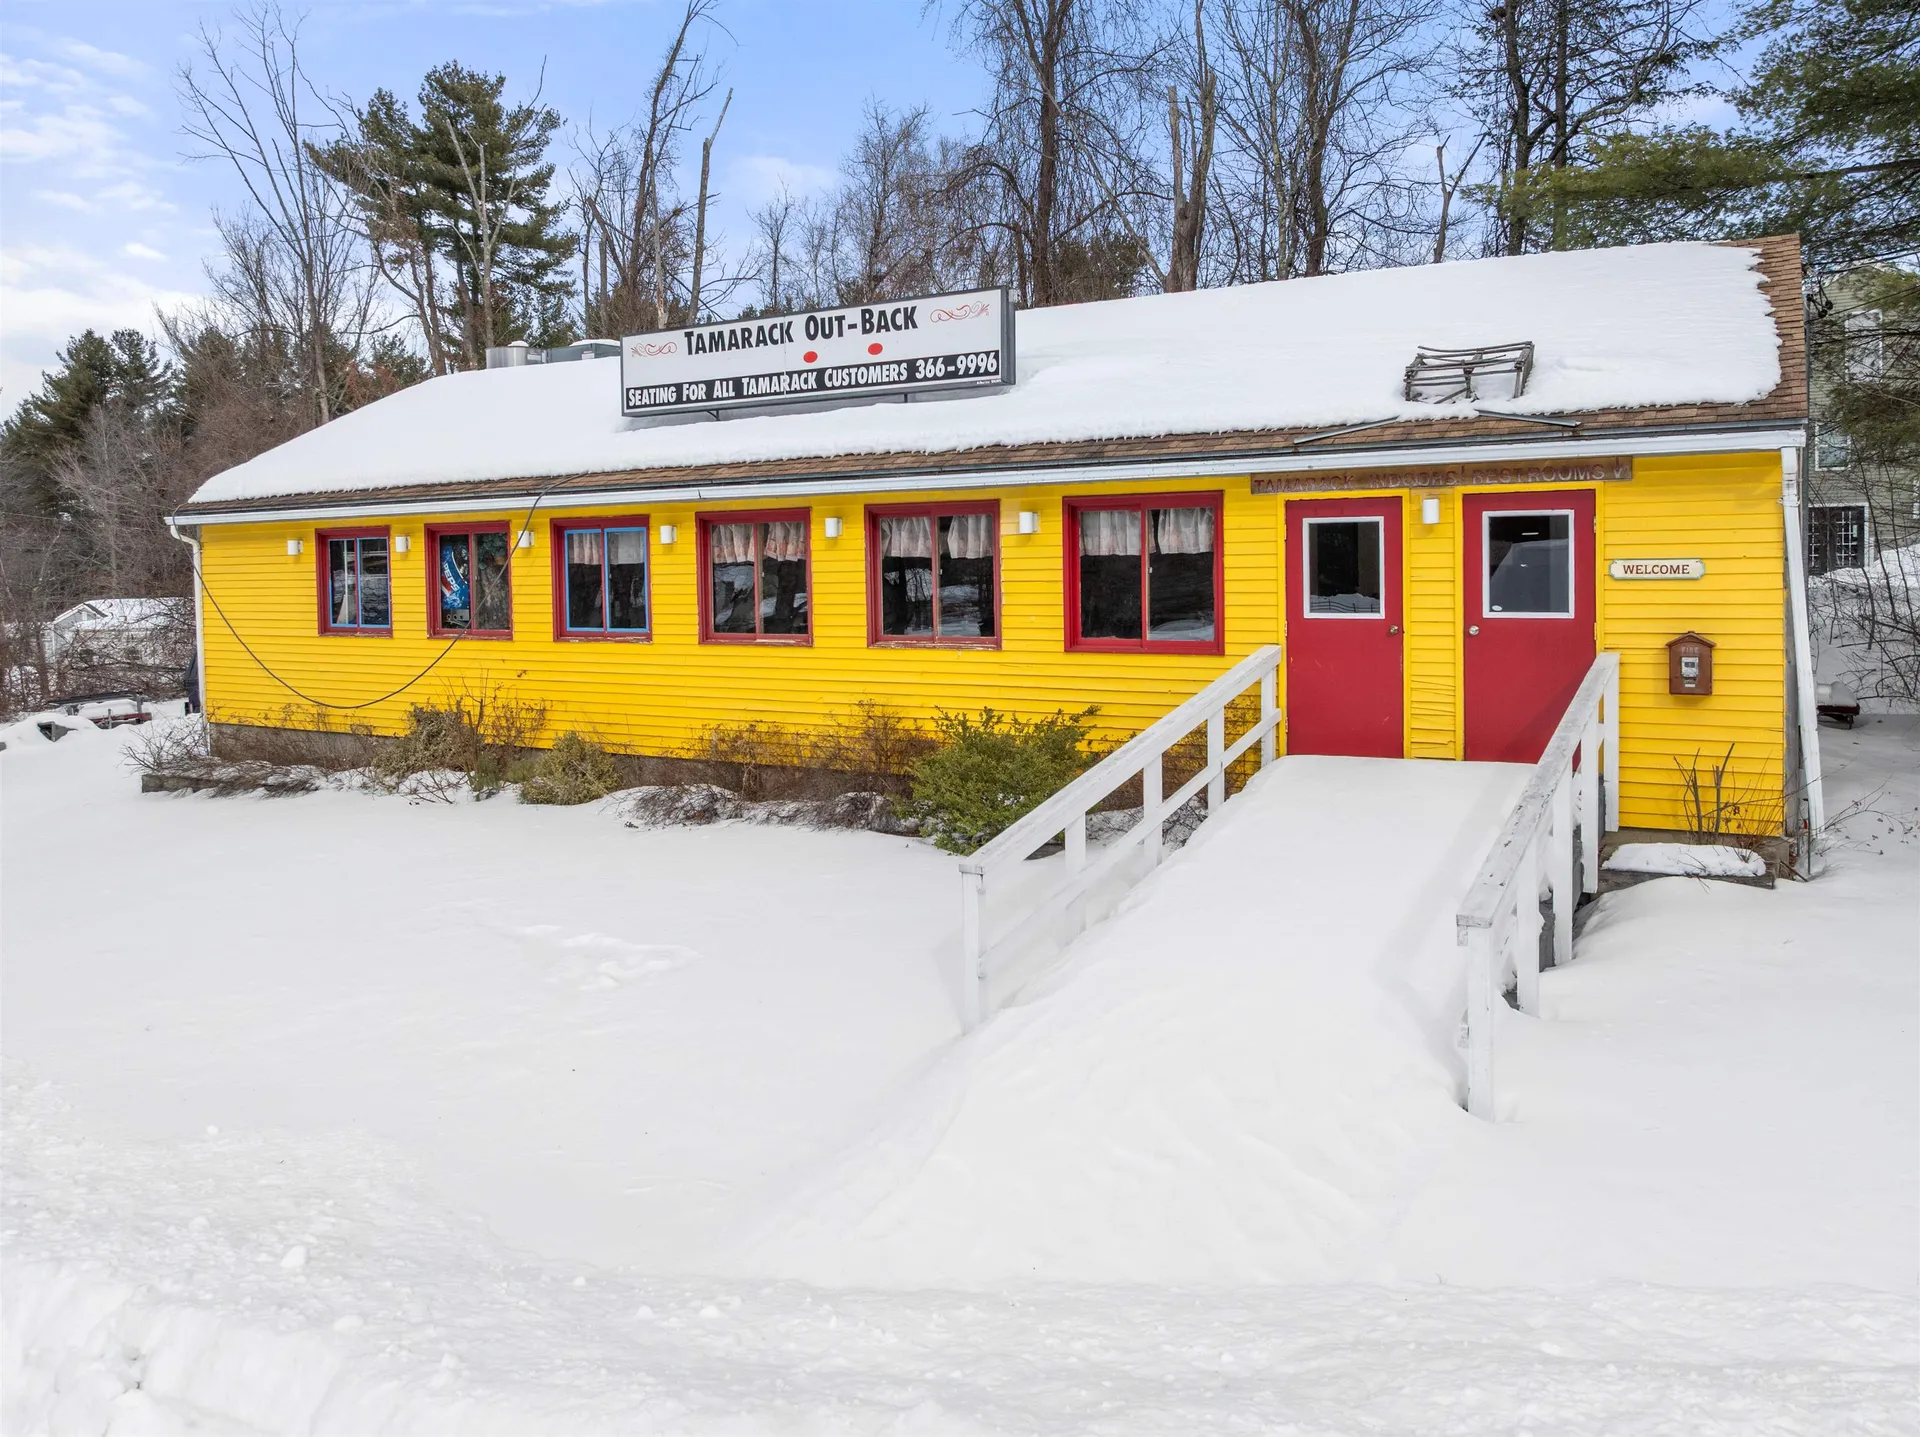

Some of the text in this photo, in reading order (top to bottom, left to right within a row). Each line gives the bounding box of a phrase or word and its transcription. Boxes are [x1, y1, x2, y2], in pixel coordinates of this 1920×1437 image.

[684, 305, 918, 355] TAMARACK OUT-BACK
[628, 352, 998, 406] SEATING FOR ALL TAMARACK CUSTOMERS 366-9996
[1254, 474, 1355, 493] TAMARACK
[1472, 463, 1605, 484] RESTROOMS
[1622, 564, 1690, 575] WELCOME
